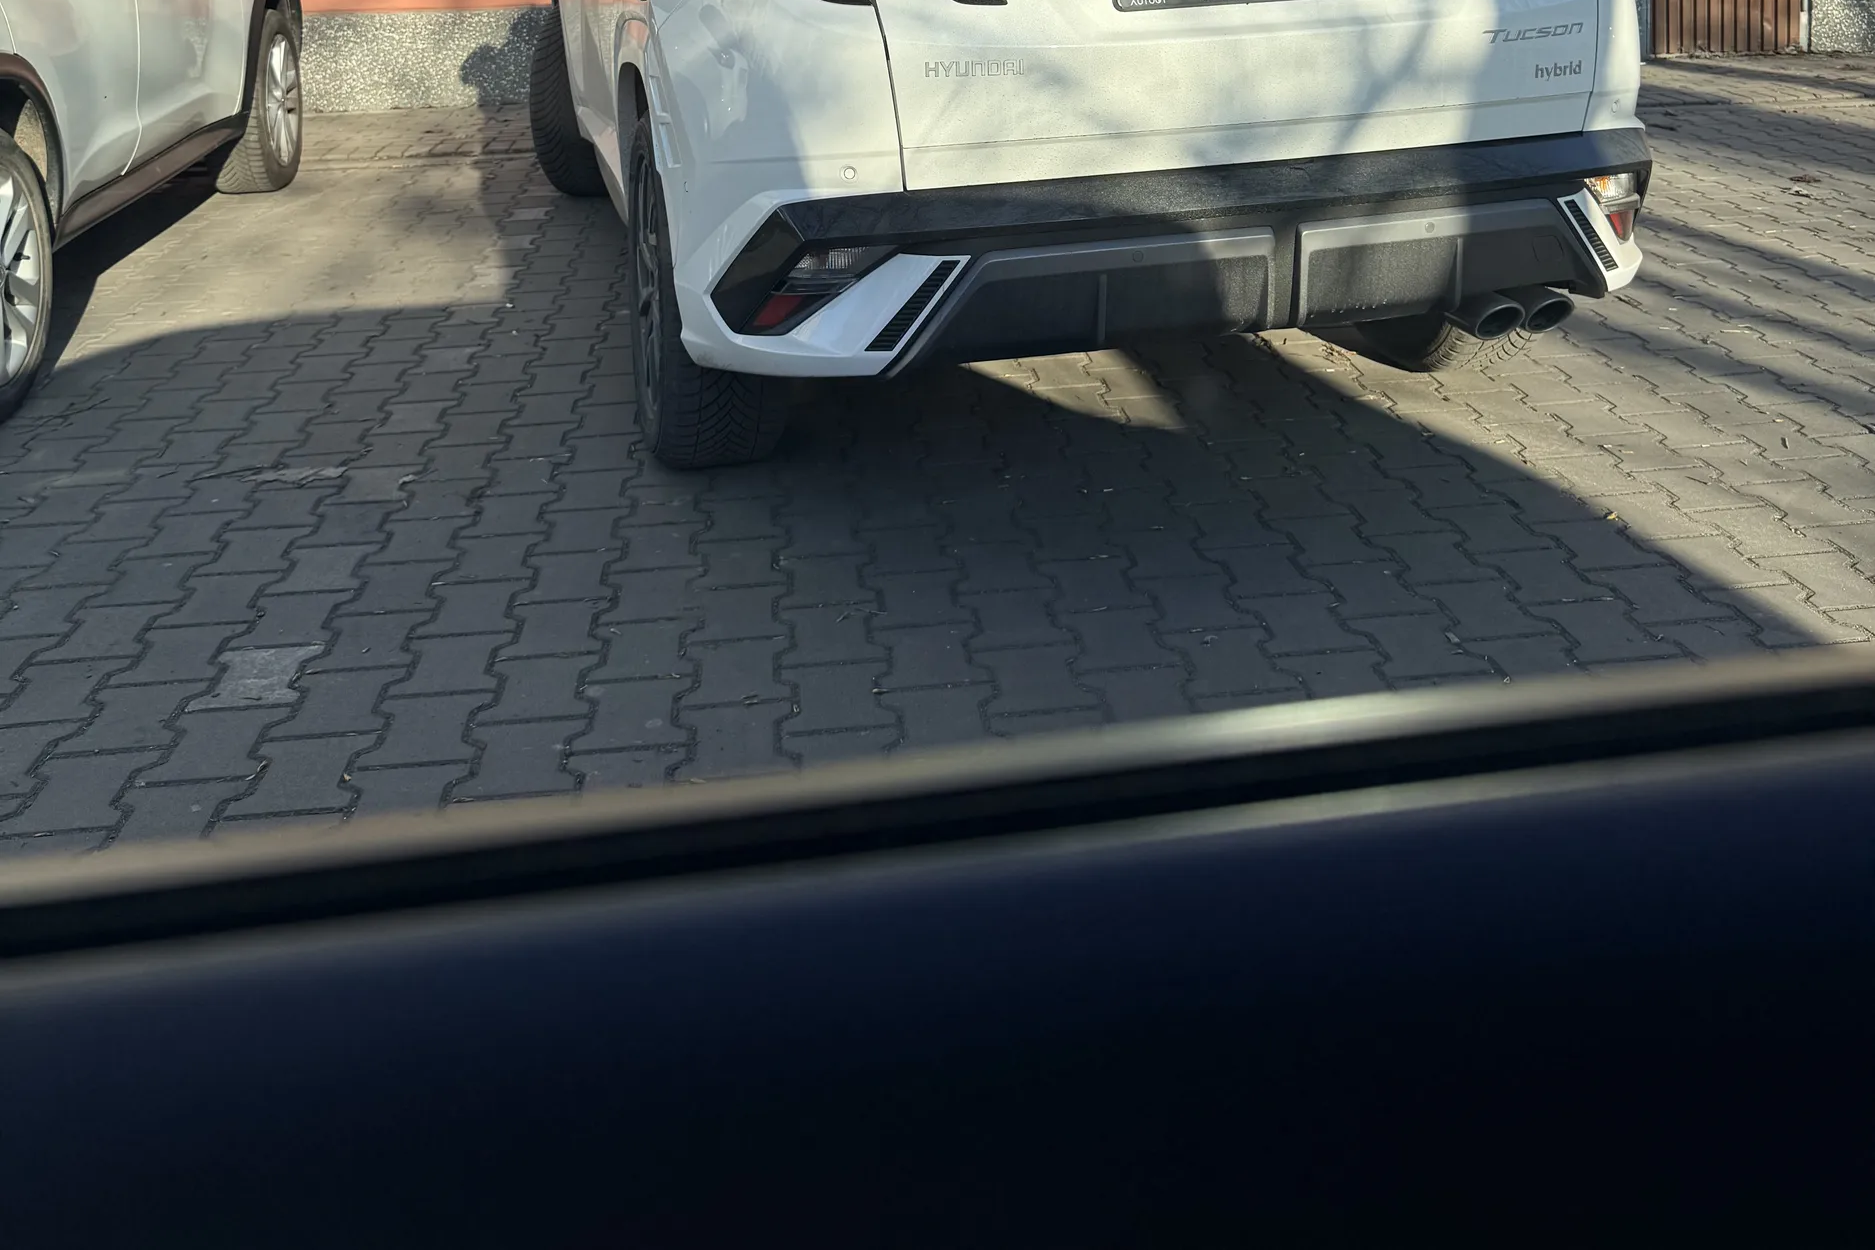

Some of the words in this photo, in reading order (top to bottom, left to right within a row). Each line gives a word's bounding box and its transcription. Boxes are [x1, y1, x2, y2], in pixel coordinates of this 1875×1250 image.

[1482, 22, 1584, 44] TUCSON
[924, 59, 1025, 78] HYUNDAI
[1534, 59, 1582, 81] hybrid
